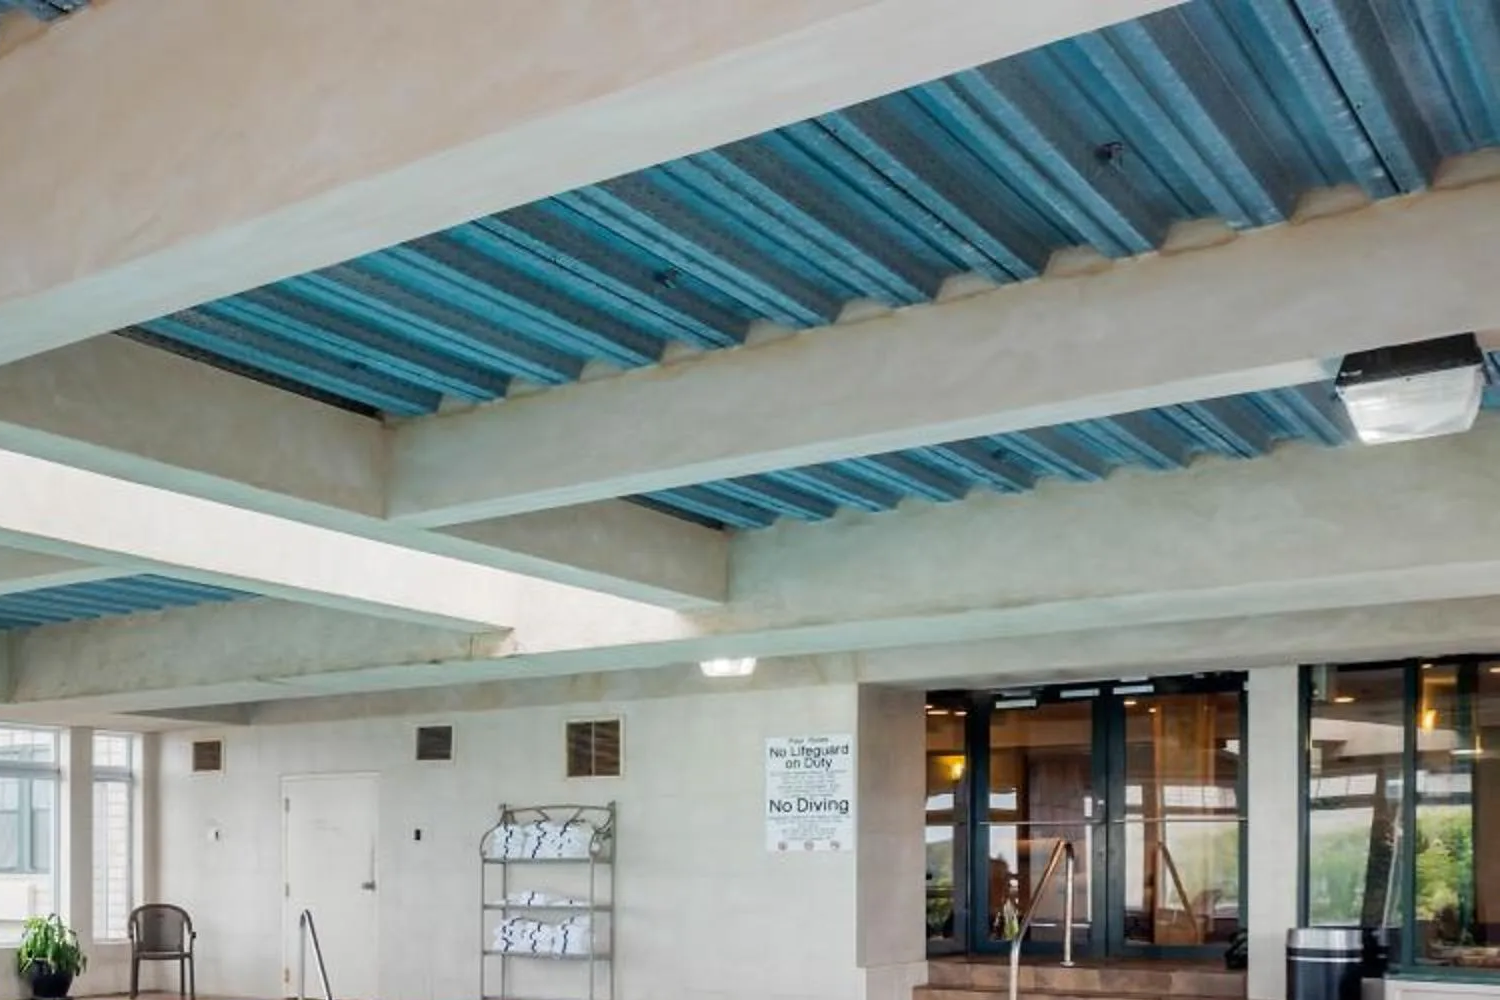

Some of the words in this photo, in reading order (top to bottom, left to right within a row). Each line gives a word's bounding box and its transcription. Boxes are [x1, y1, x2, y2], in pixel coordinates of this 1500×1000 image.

[769, 747, 787, 758] No
[785, 760, 801, 769] on
[769, 799, 793, 813] No
[797, 797, 849, 815] Diving
